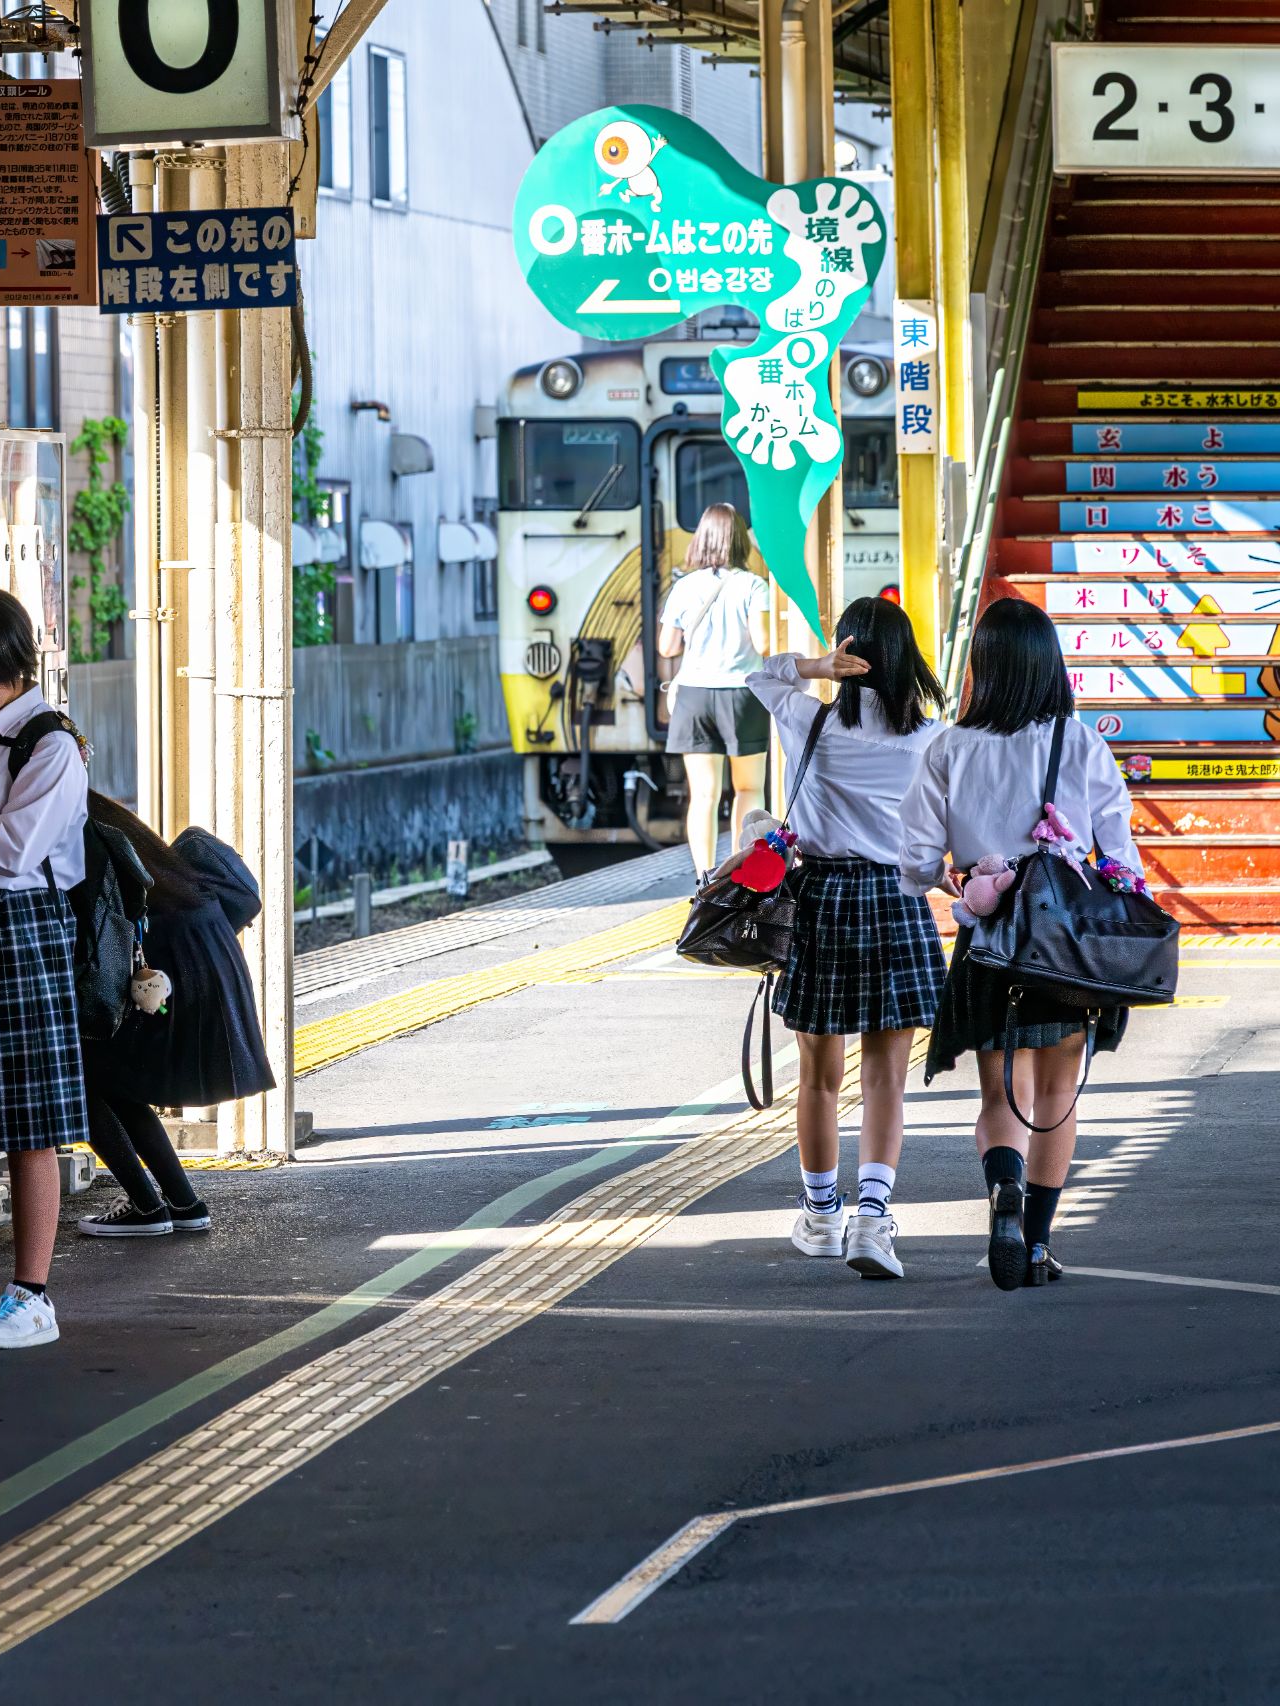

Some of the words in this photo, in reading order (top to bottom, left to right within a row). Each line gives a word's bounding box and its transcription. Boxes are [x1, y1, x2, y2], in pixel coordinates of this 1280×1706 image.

[166, 216, 292, 254] この先の
[102, 260, 294, 306] 階段左側です
[899, 317, 932, 435] 東階段
